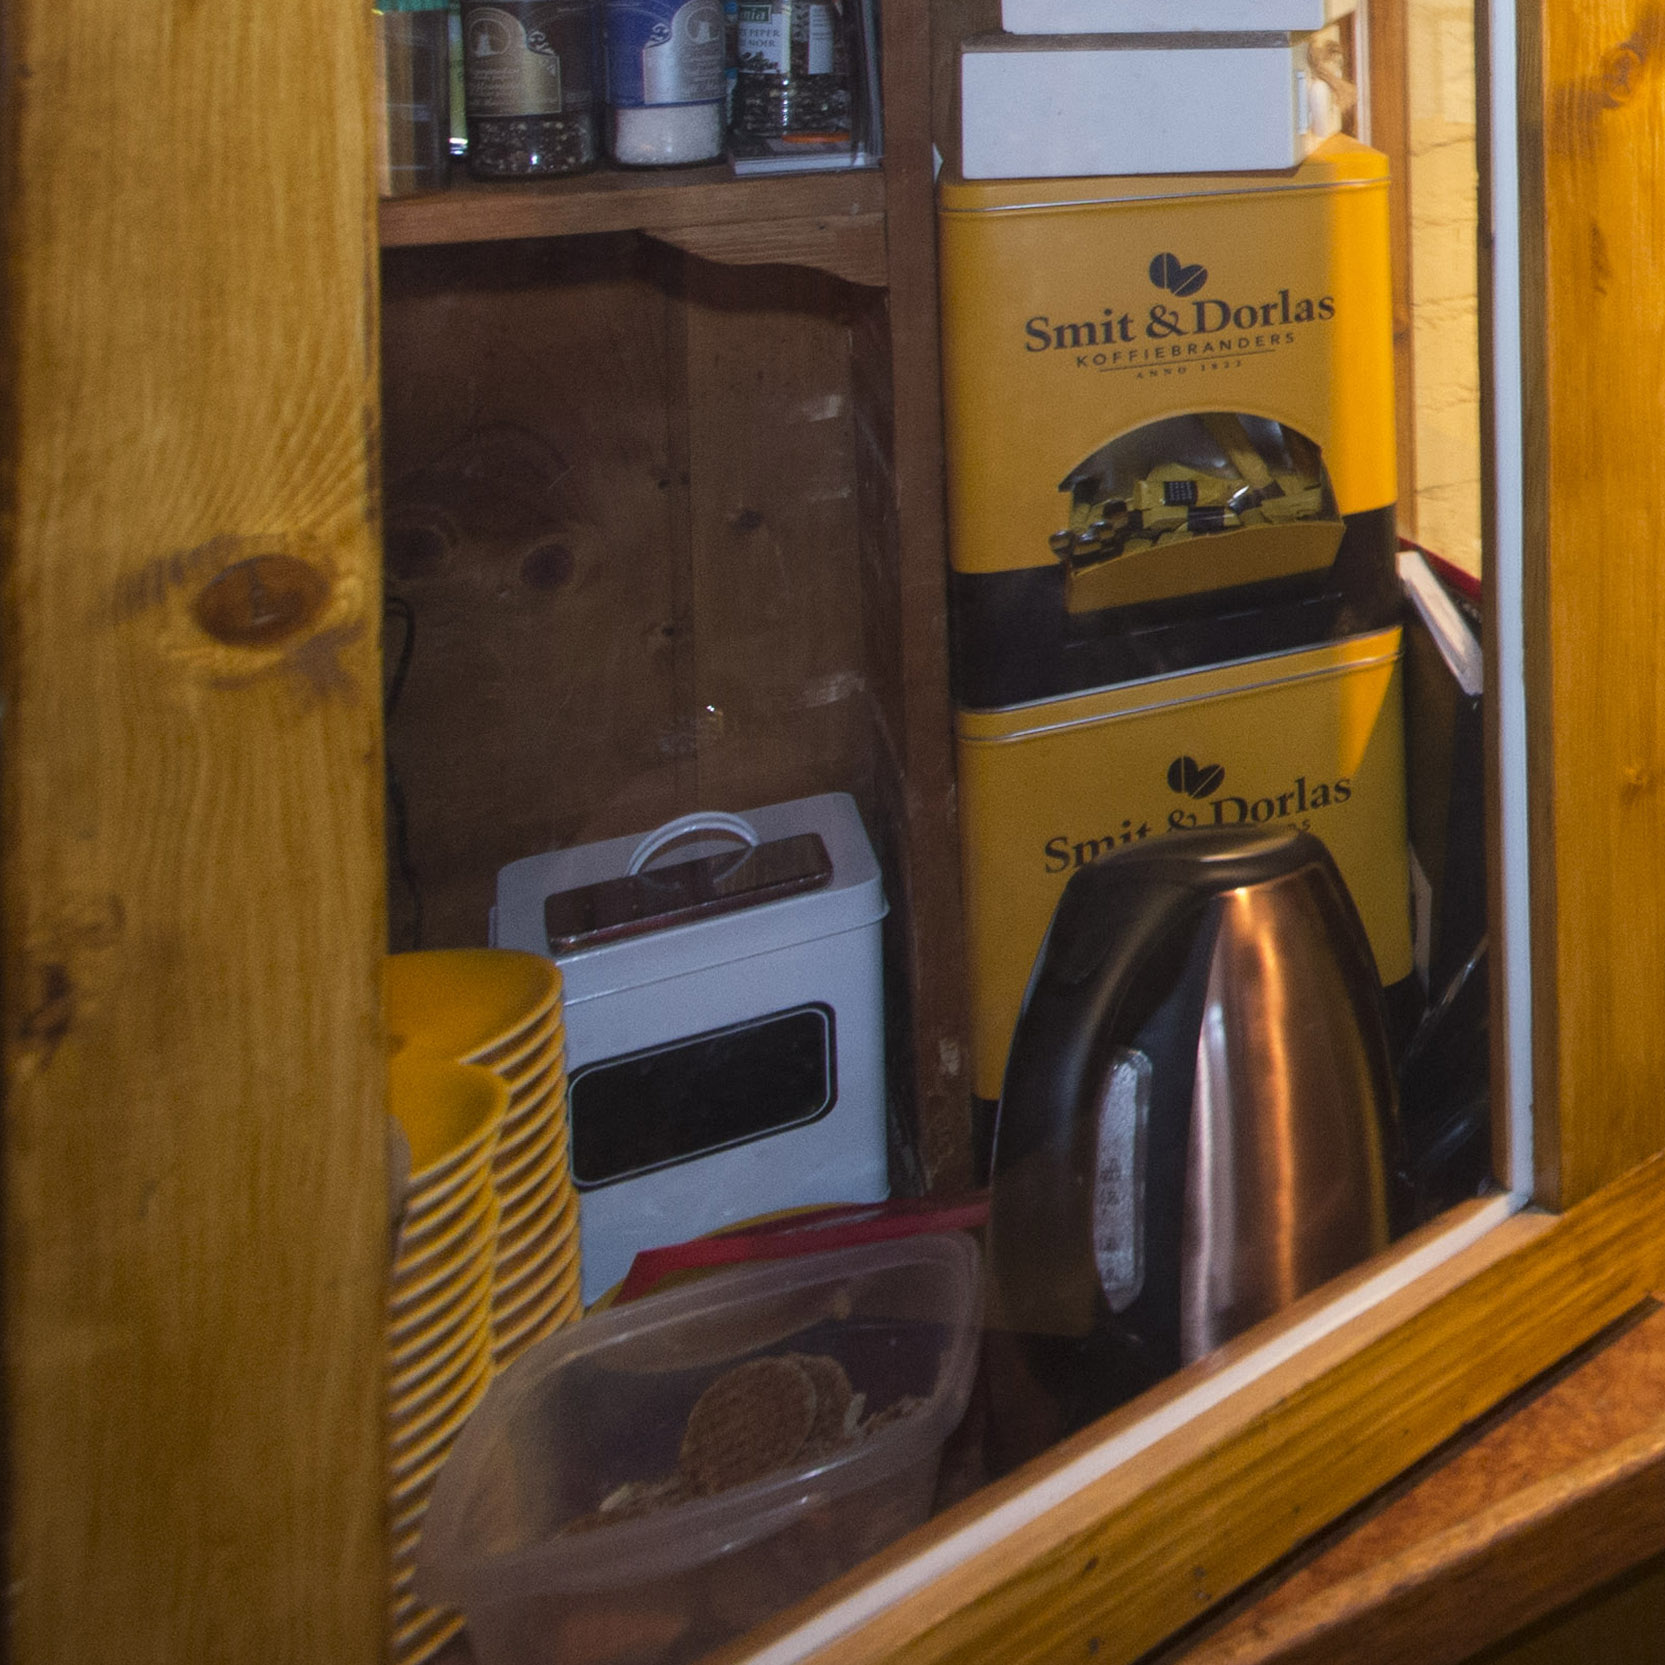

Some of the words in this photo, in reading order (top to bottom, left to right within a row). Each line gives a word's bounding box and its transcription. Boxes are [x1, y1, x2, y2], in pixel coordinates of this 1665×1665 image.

[1025, 308, 1137, 352] Smit
[1146, 304, 1189, 339] &
[1193, 289, 1336, 334] Dorlas
[1076, 332, 1297, 368] KOFFIEBRANDERS
[1136, 365, 1187, 379] ANNO
[1210, 776, 1352, 824] Dorlas
